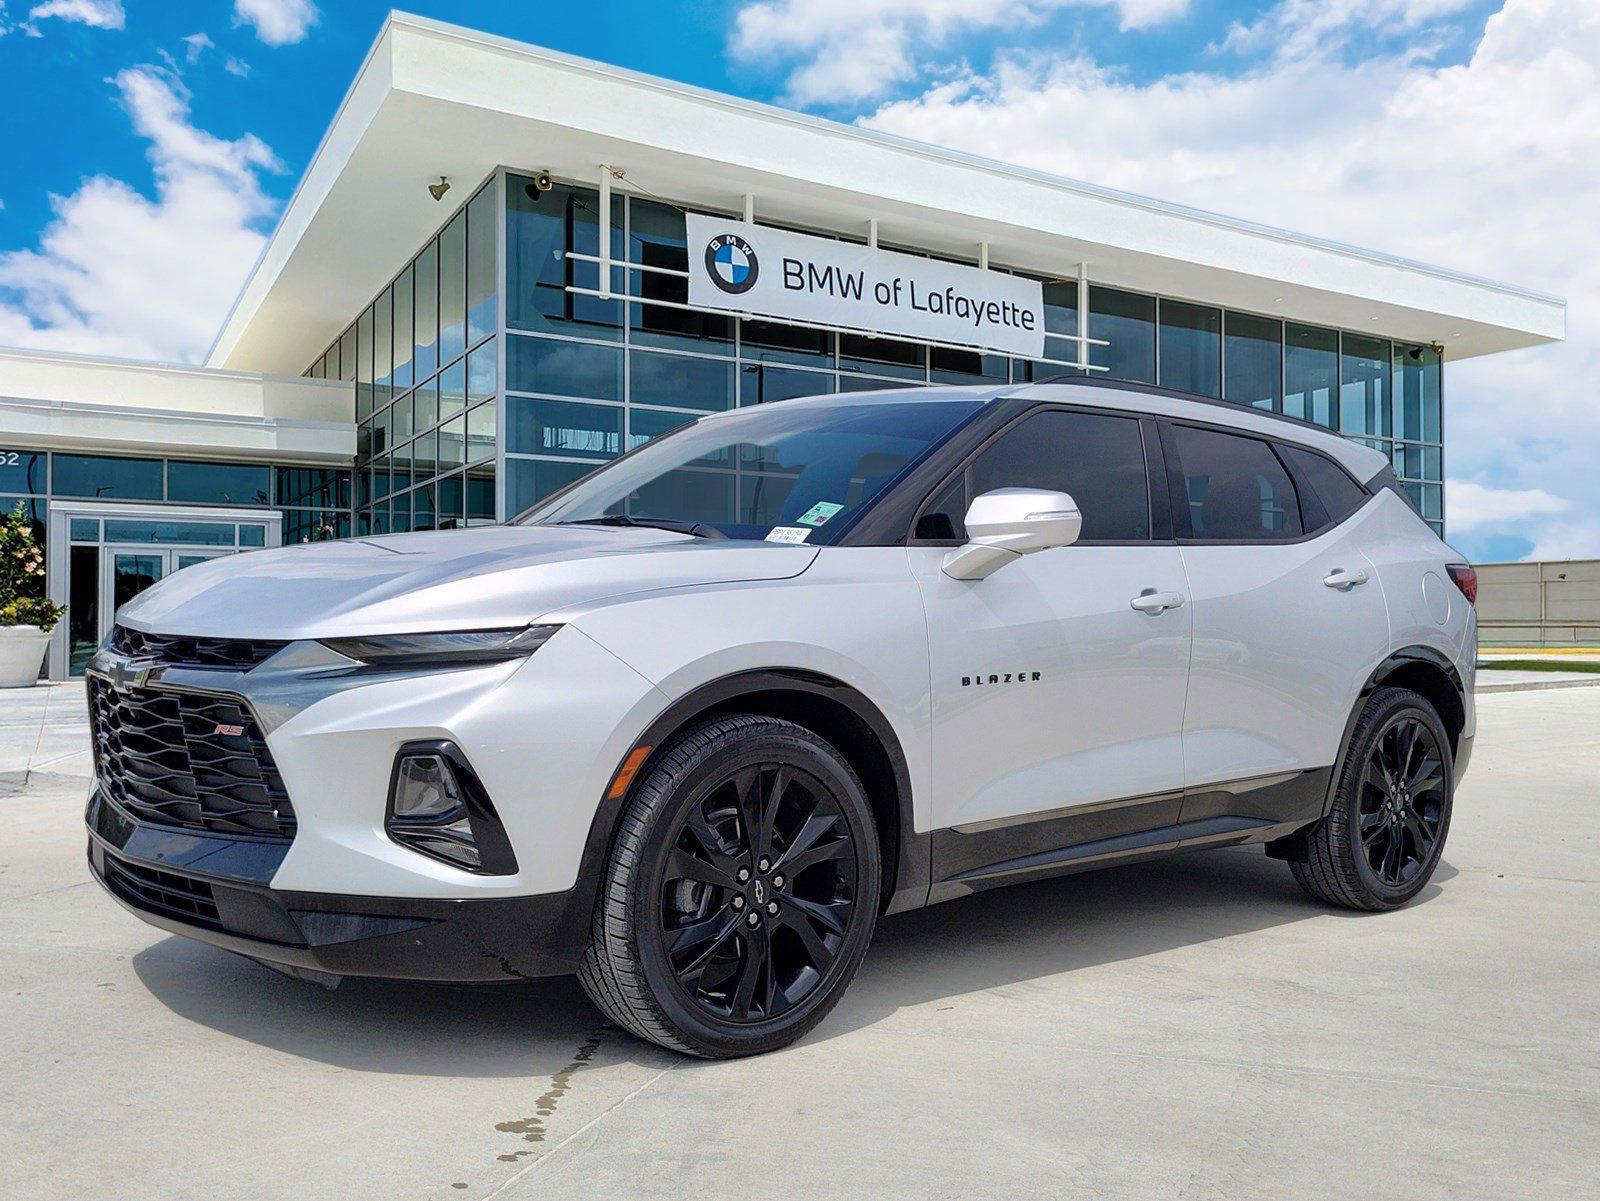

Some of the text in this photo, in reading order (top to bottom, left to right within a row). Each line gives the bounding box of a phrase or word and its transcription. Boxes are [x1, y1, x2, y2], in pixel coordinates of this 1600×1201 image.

[710, 235, 752, 256] BMW
[783, 258, 1035, 331] BMW of Lafayette
[961, 671, 1041, 686] BLAZER
[214, 724, 244, 736] RS
